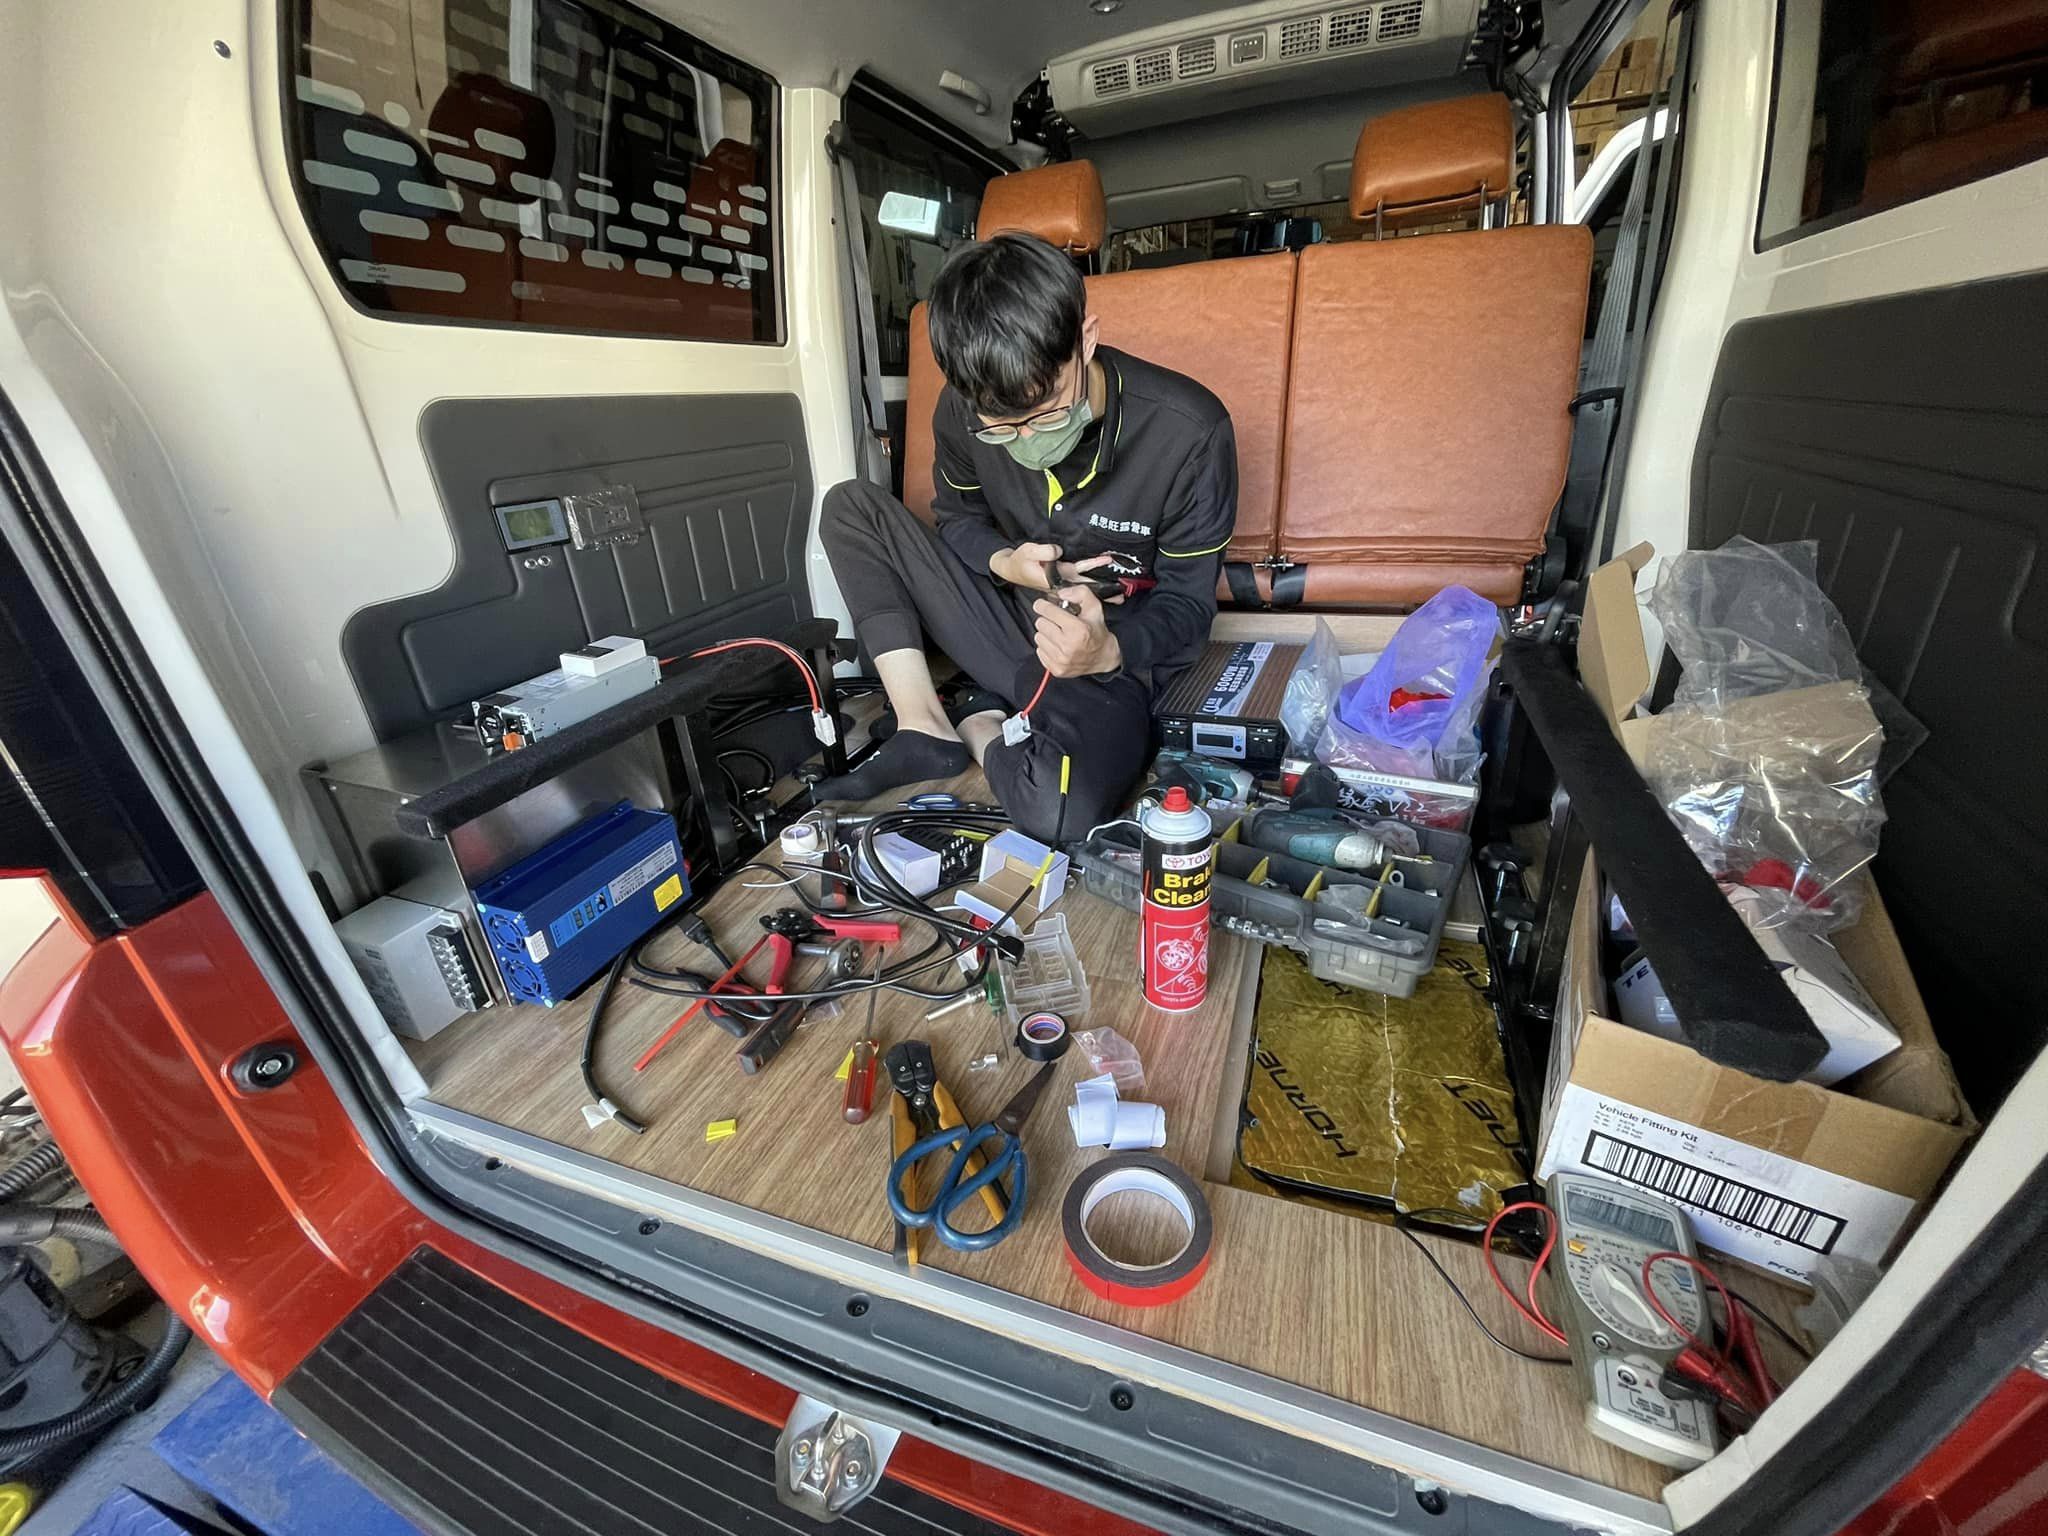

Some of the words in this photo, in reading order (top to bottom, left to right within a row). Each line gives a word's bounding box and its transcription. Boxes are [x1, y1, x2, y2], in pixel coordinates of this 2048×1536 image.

[1256, 1041, 1359, 1159] HORNE
[1598, 1101, 1639, 1123] Vehicle
[1641, 1116, 1679, 1138] Fitting
[1680, 1127, 1699, 1143] Kit
[1717, 1217, 1763, 1239] 10678
